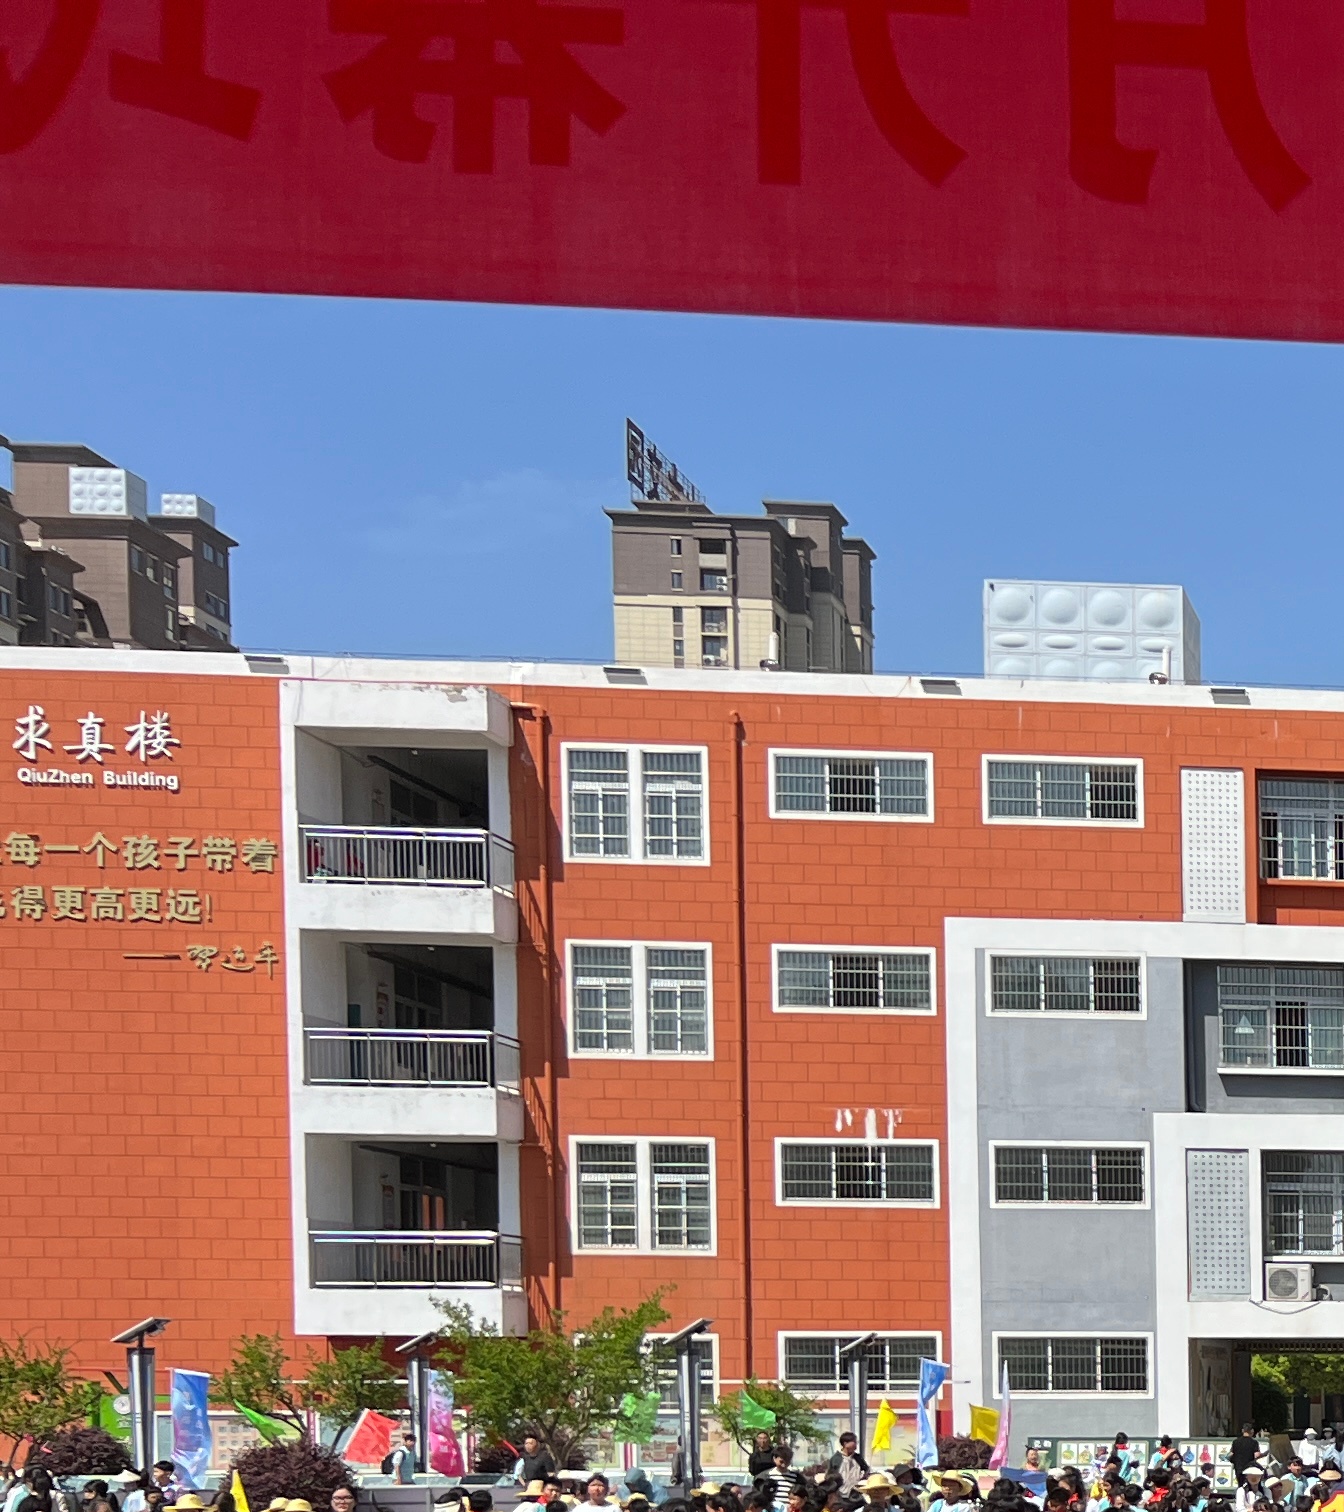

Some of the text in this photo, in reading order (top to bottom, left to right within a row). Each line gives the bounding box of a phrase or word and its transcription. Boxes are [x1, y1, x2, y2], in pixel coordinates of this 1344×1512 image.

[12, 705, 181, 764] 求真楼
[17, 768, 180, 790] QiuZhen Building
